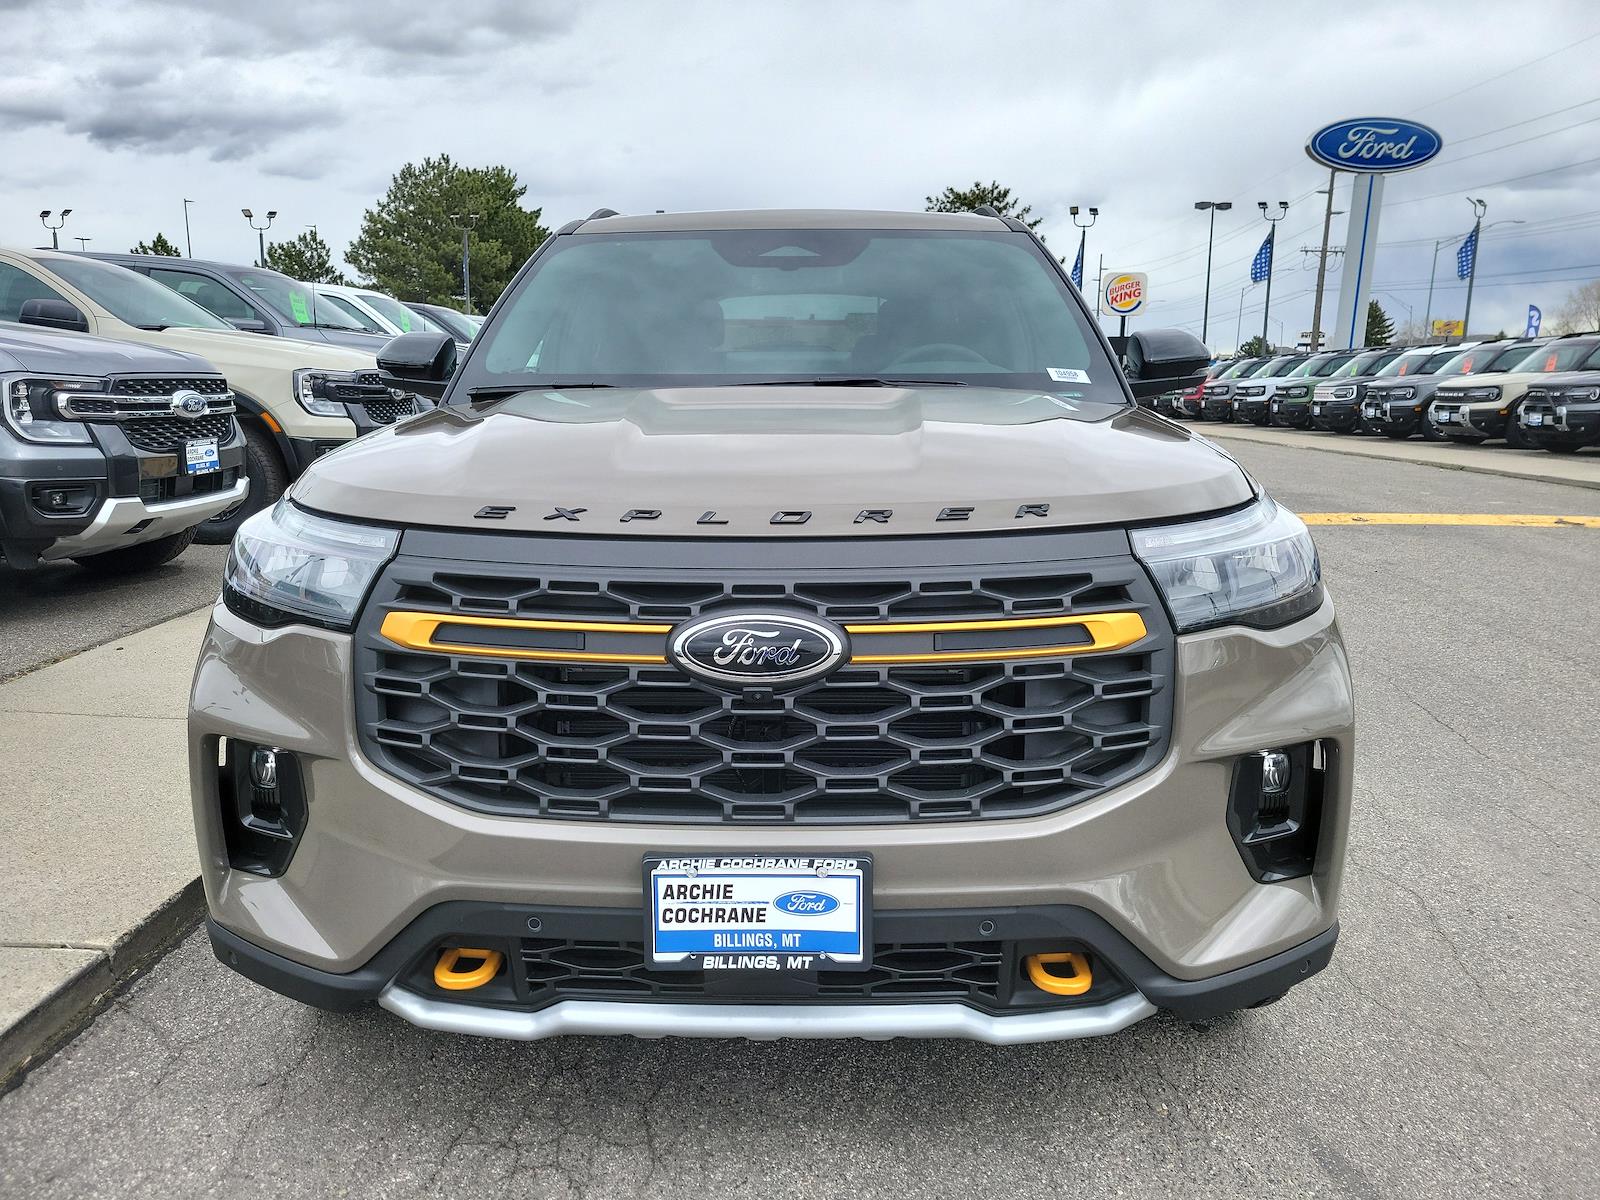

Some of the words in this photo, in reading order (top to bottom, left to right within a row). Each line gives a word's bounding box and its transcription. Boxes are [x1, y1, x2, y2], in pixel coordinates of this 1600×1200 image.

[1338, 126, 1417, 159] Ford
[1109, 281, 1141, 296] BURGER
[1110, 288, 1142, 305] KING
[187, 398, 203, 411] Ford
[473, 501, 1051, 525] EXPLORER
[713, 628, 803, 665] Ford
[657, 859, 716, 871] ARCHIE
[720, 859, 810, 870] COCHRANE
[814, 859, 858, 870] FORD
[662, 884, 734, 900] ARCHIE
[787, 893, 827, 912] Ford
[662, 907, 767, 924] COCHRANE
[713, 933, 778, 950] BILLINGS,
[782, 933, 802, 948] MT
[702, 955, 782, 970] BILLINGS,
[786, 956, 814, 969] MT
